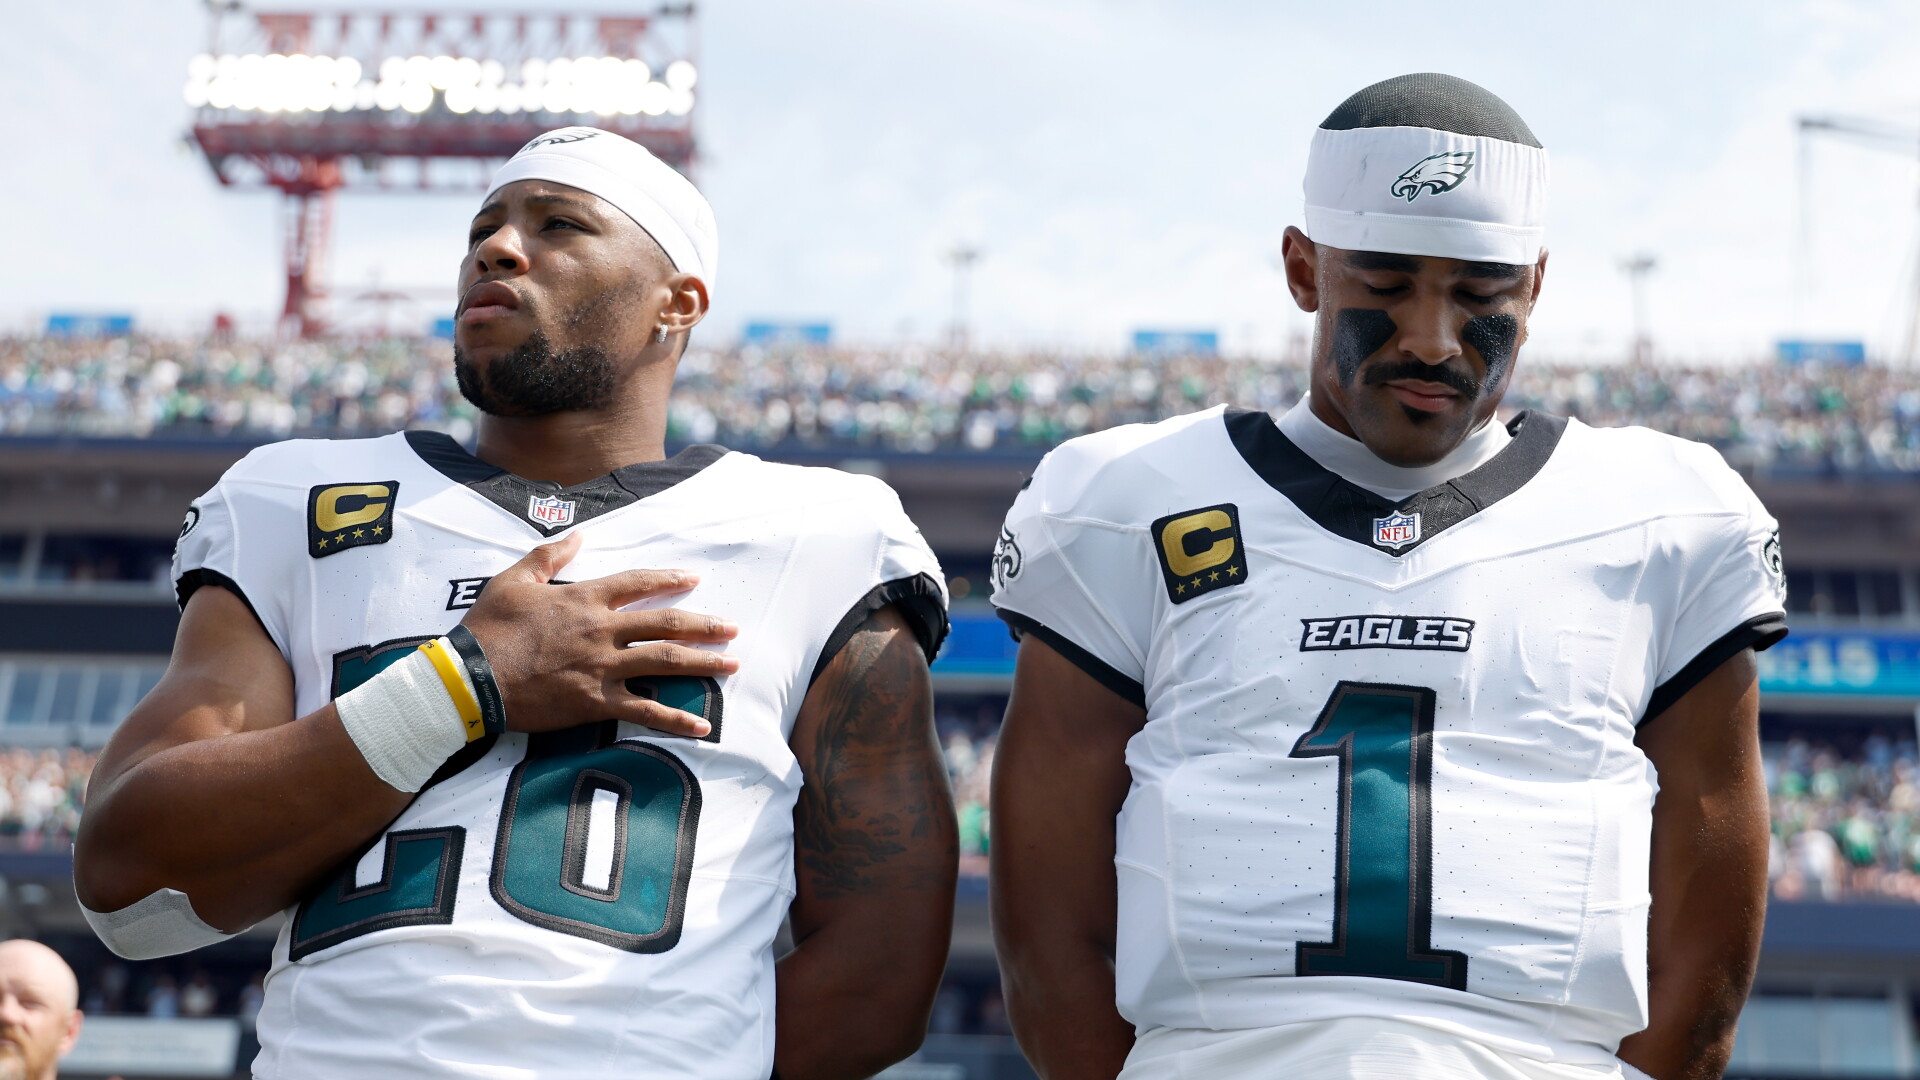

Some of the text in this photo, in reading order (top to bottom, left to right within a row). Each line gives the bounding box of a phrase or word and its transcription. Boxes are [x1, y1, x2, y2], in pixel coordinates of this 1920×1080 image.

[316, 485, 390, 533] C
[536, 506, 566, 521] NFL
[1162, 510, 1235, 577] C
[1381, 526, 1411, 541] NFL
[1301, 615, 1474, 650] EAGLES
[1288, 680, 1468, 992] 1
